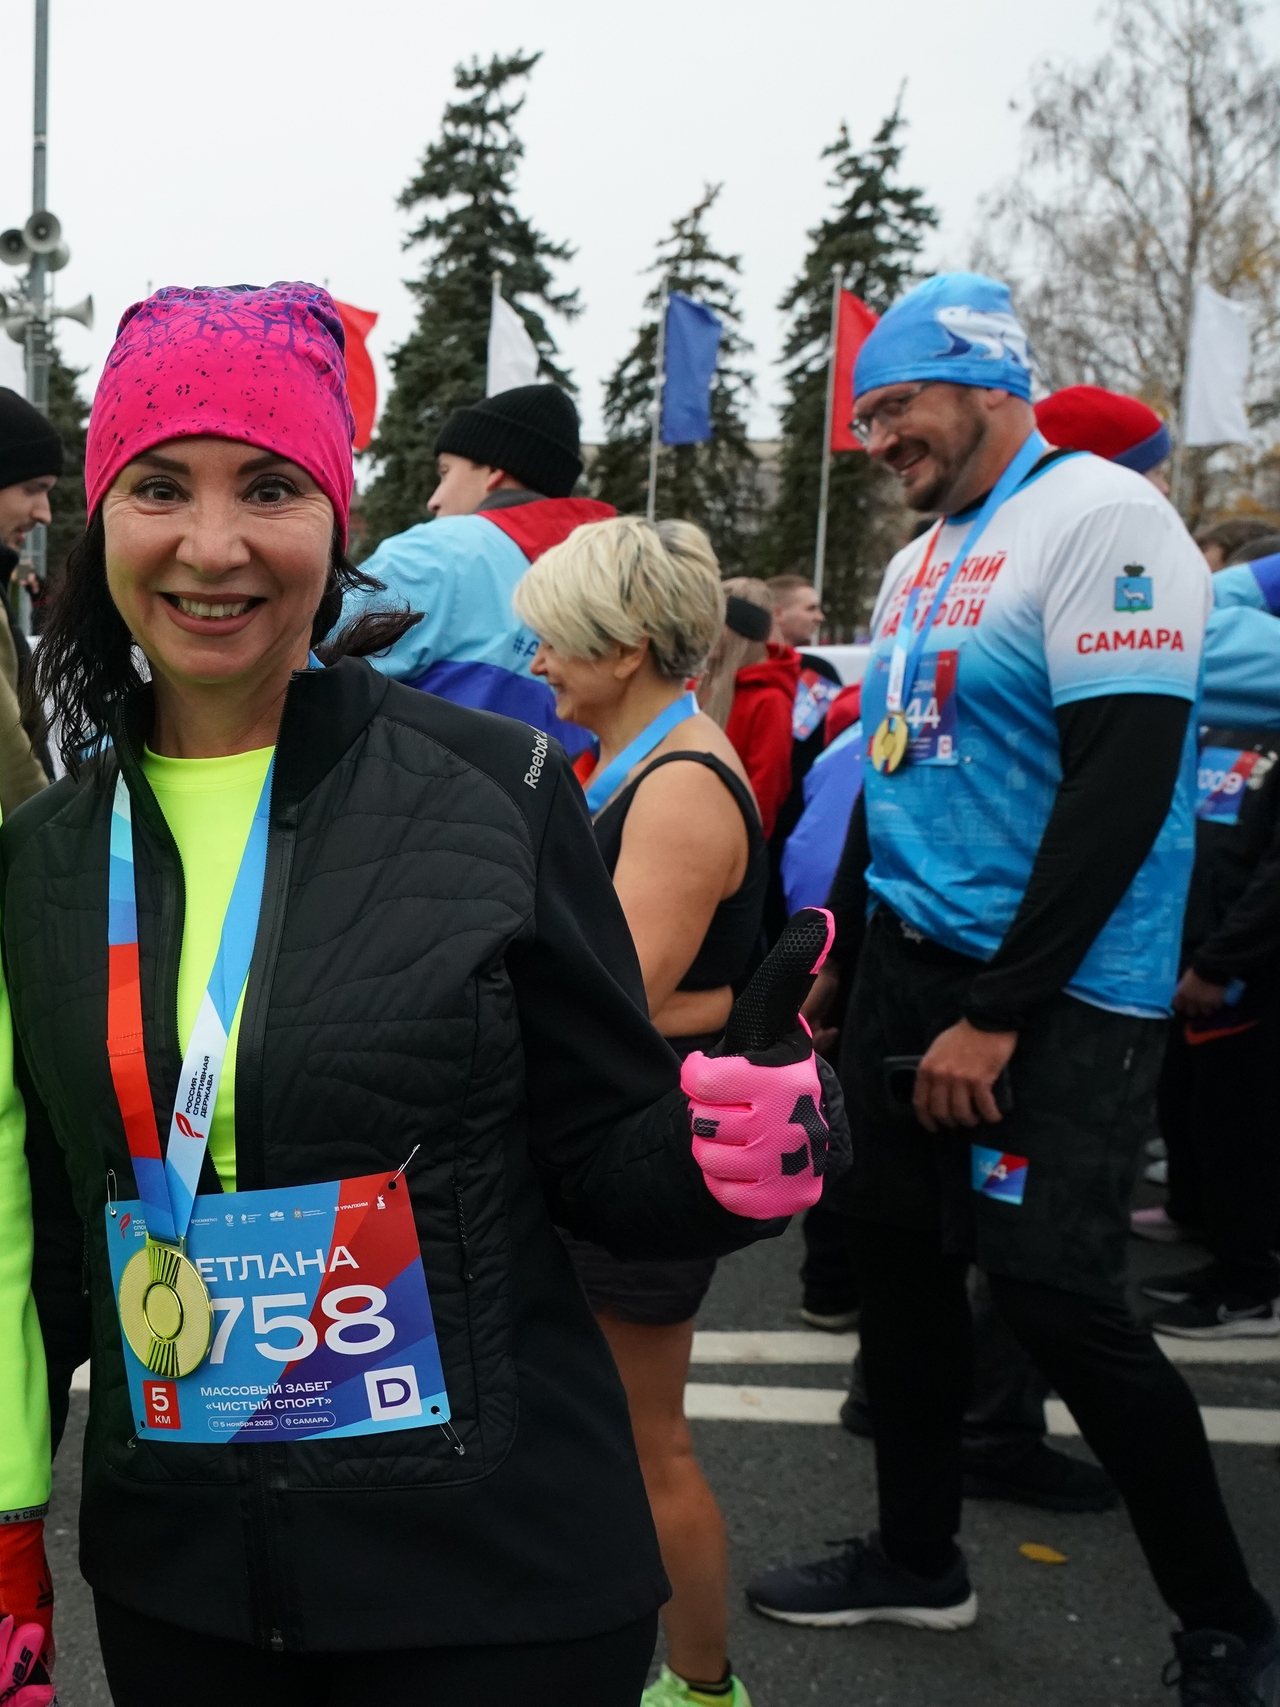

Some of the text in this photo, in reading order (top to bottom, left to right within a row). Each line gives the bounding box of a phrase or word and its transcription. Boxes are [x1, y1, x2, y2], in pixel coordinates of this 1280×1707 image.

[1077, 629, 1184, 655] САМАРА
[906, 697, 941, 730] 44
[523, 734, 548, 789] Reebok
[185, 1077, 198, 1114] РОССИЯ
[193, 1055, 210, 1116] СПОРТИВНАЯ
[200, 1074, 214, 1119] ДЕРЖАВА
[340, 1202, 369, 1211] УРАЛХИМ
[196, 1245, 360, 1283] ЕТЛАНА
[209, 1284, 396, 1365] 758
[151, 1387, 170, 1412] 5
[200, 1381, 332, 1397] МАССОВЫЙ ЗАБЕГ
[375, 1377, 412, 1409] D
[206, 1397, 332, 1412] «ЧИСТЫЙ СПОРТ»
[154, 1414, 171, 1425] КМ
[220, 1419, 274, 1429] 5 ноября 2025
[292, 1417, 329, 1425] САМАРА
